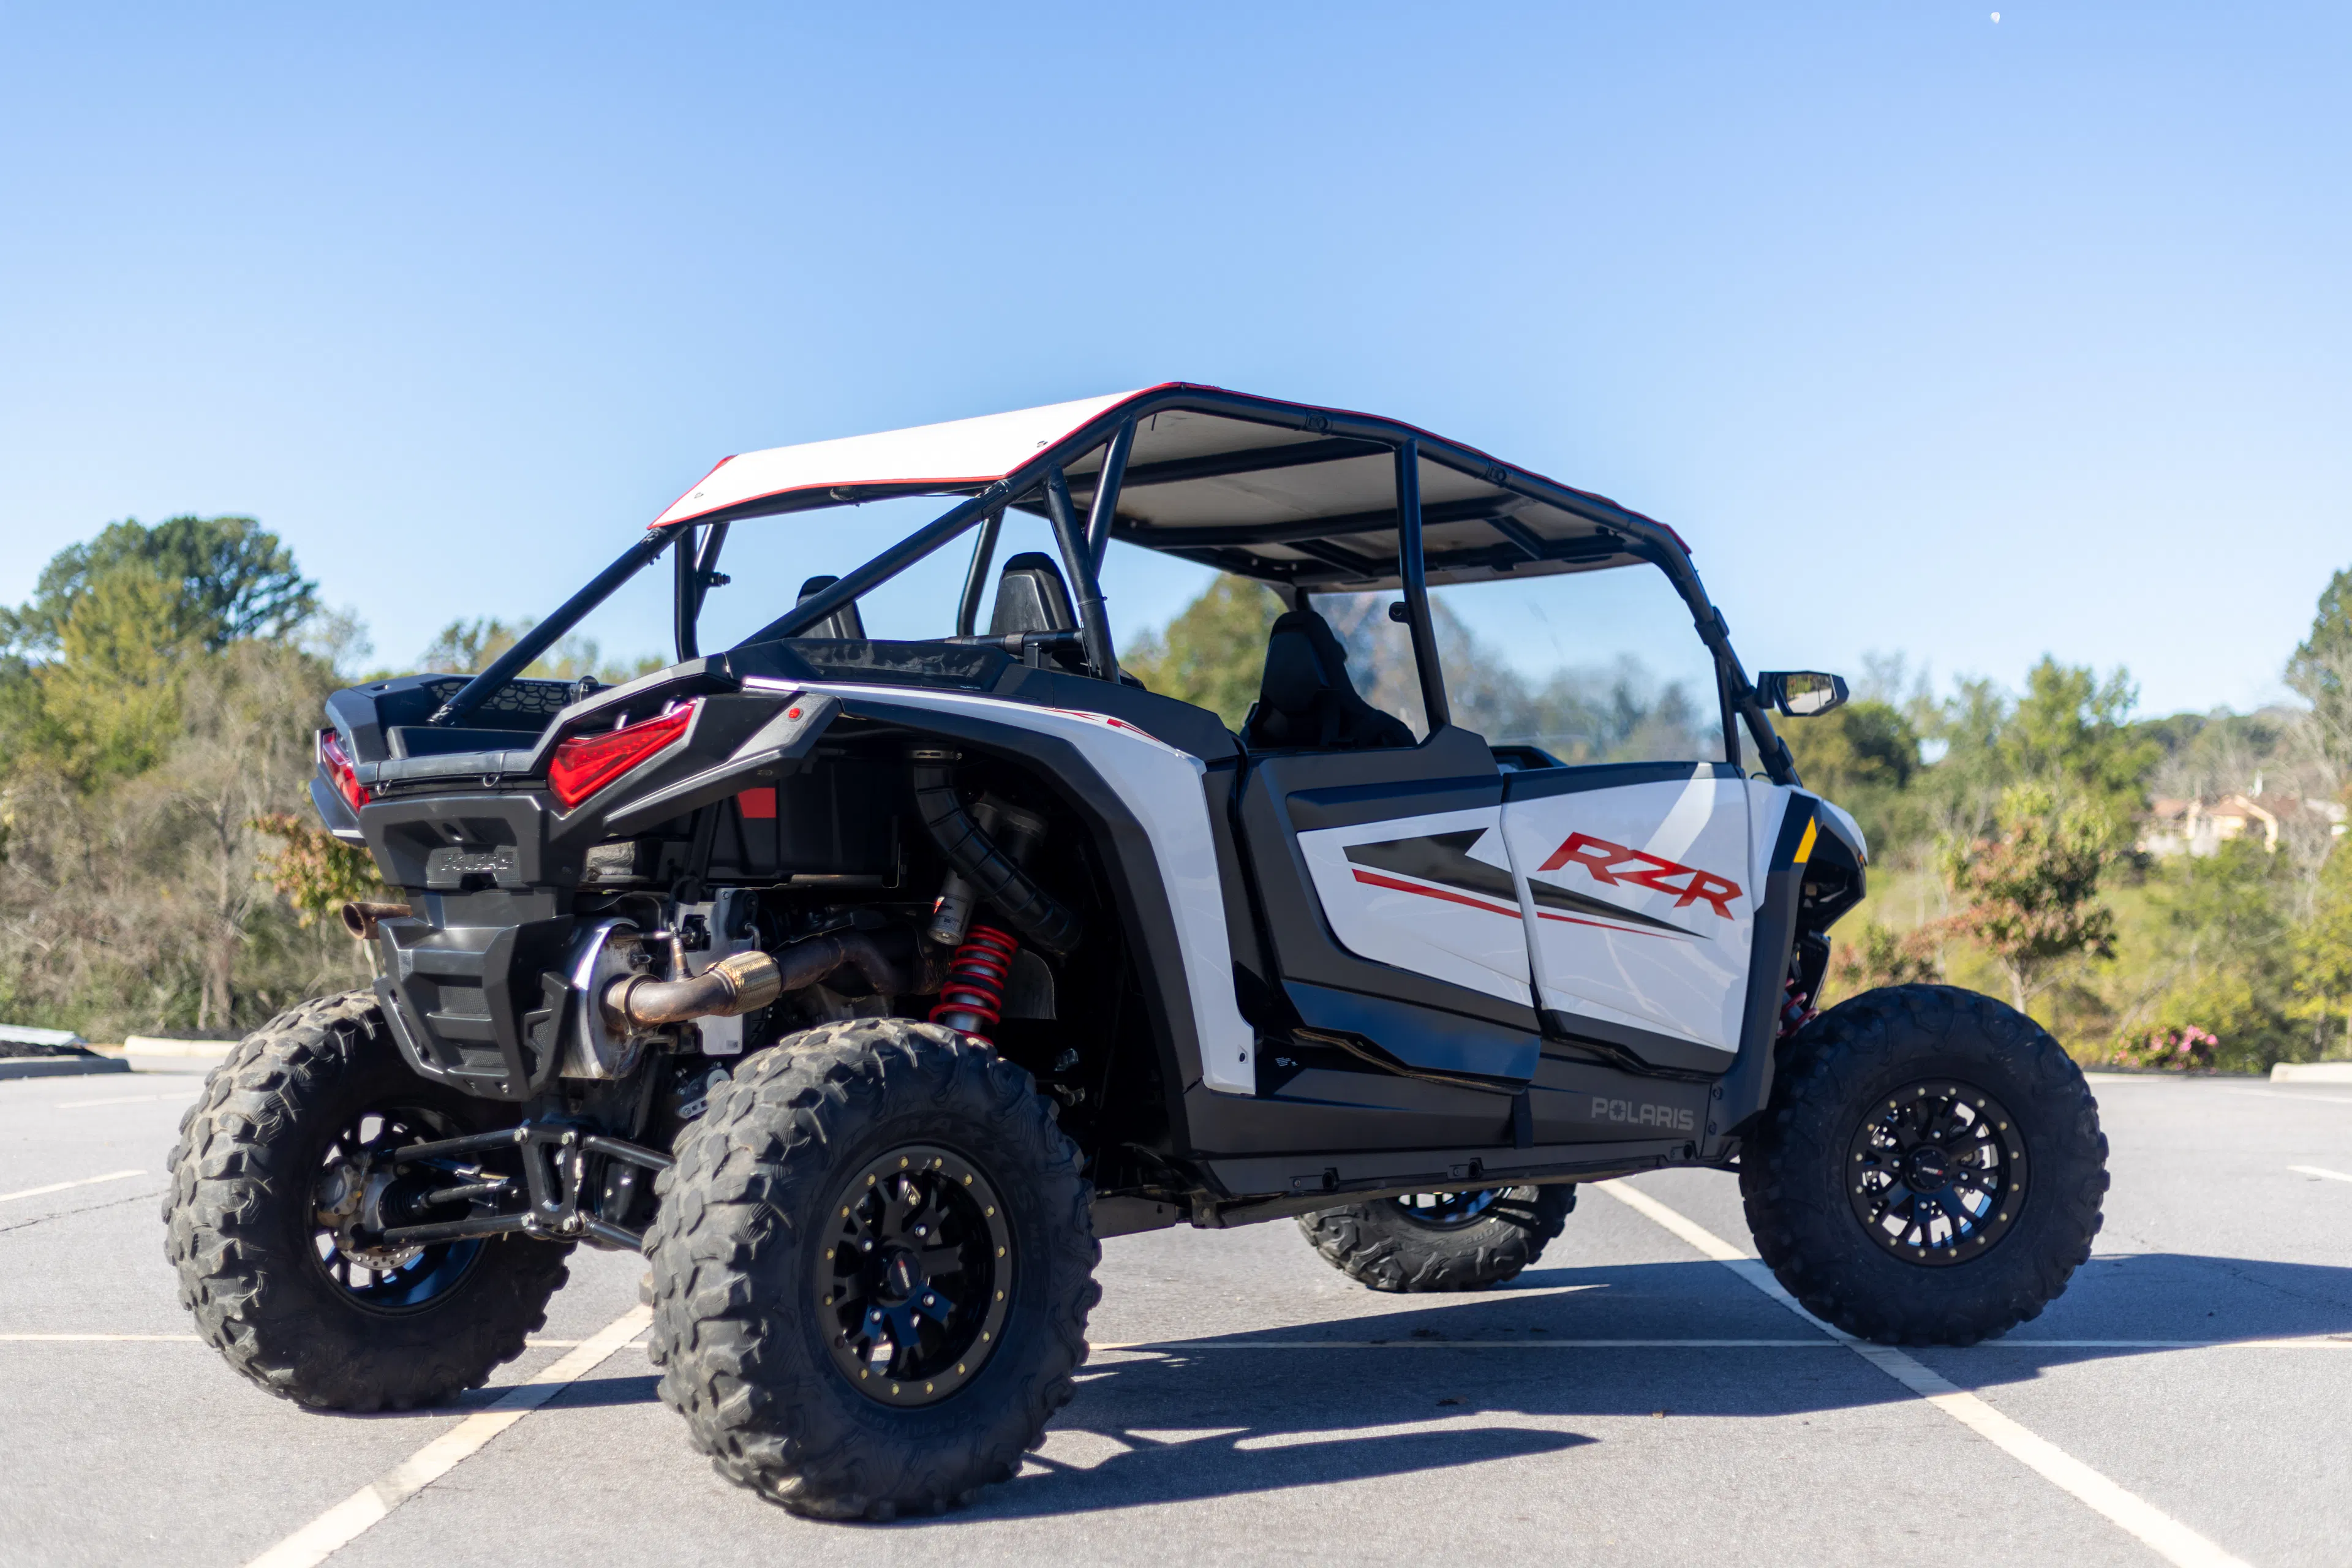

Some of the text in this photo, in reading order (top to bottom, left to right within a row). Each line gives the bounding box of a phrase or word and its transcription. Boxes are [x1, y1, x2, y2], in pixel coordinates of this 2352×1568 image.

[440, 852, 513, 872] POLARIS
[1537, 832, 1743, 921] RZR
[1591, 1097, 1694, 1131] POLARIS
